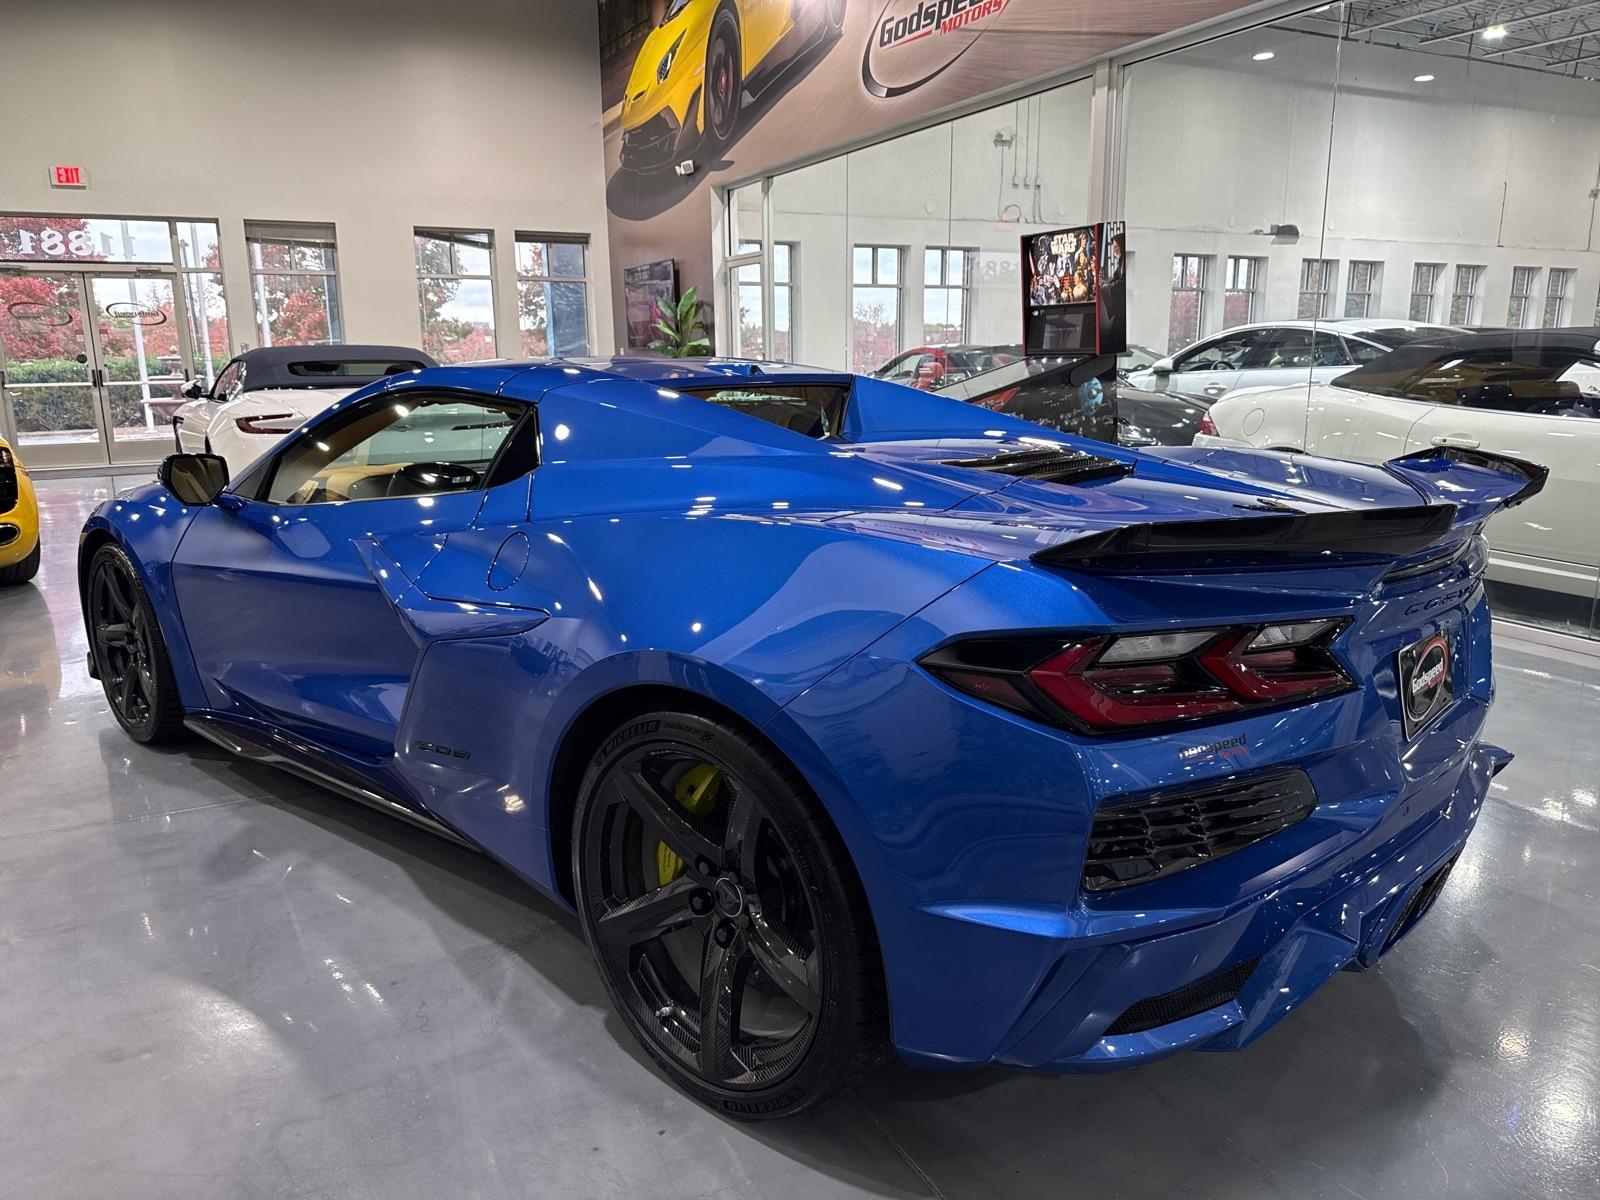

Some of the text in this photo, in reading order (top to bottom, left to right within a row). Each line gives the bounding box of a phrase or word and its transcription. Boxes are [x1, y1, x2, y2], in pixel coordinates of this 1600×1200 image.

[880, 0, 983, 48] Godspe
[940, 0, 1002, 35] MOTORS
[55, 166, 80, 184] EXIT
[1051, 241, 1076, 255] WARS
[1053, 232, 1076, 244] STAR
[1412, 657, 1444, 694] Godspeed
